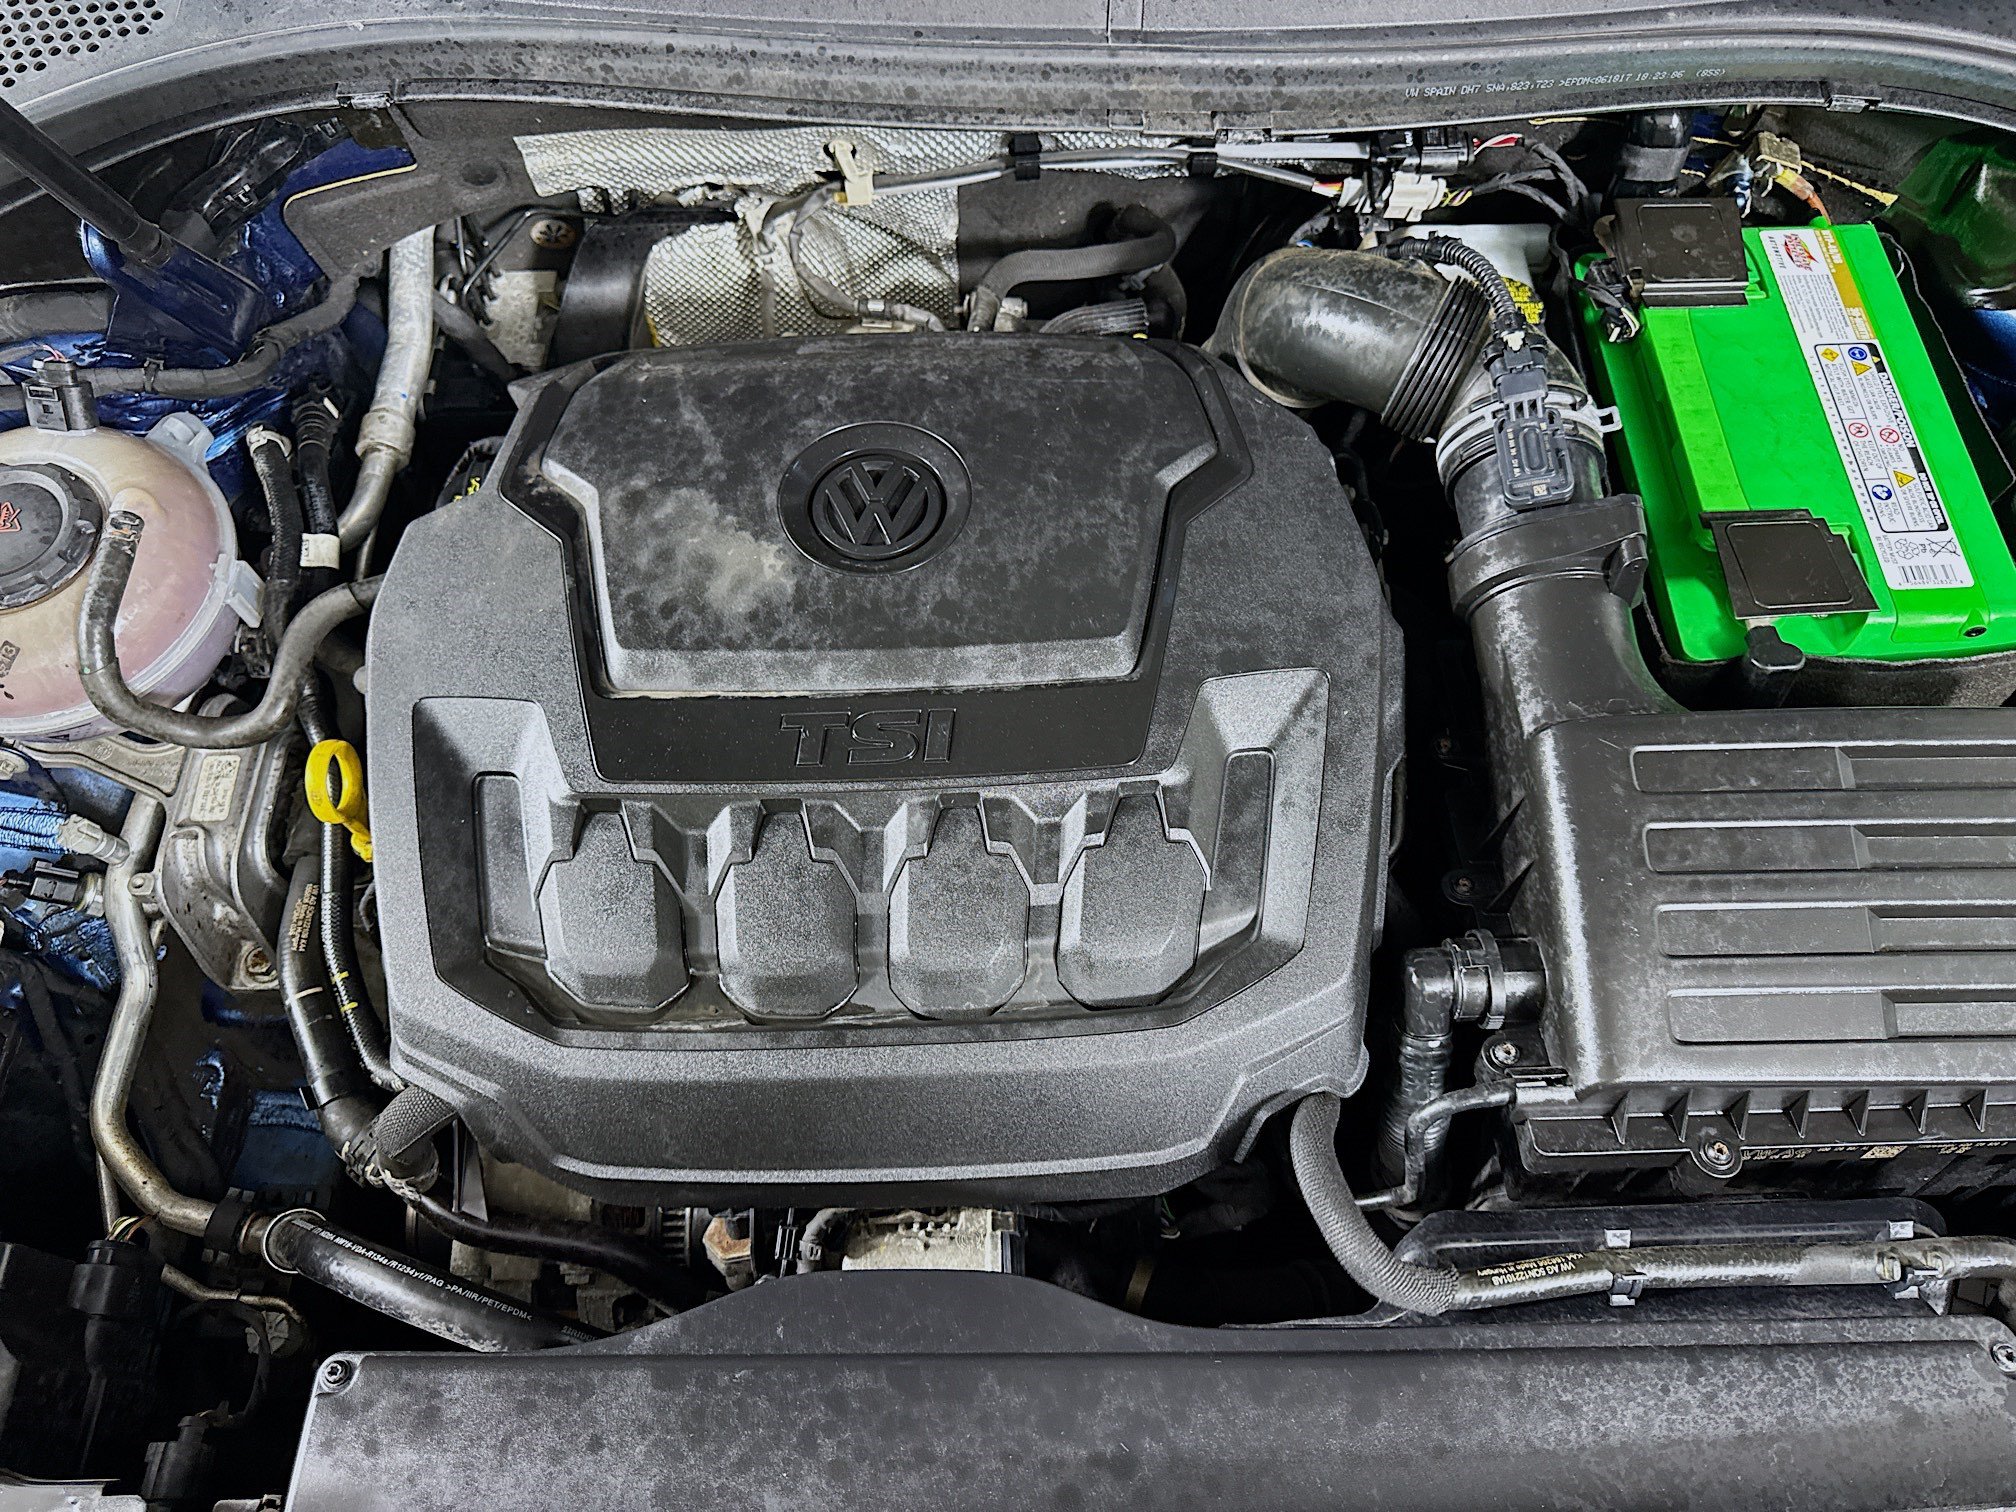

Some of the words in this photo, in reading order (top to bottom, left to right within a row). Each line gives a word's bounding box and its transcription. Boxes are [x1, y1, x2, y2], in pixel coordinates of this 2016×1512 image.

[1405, 88, 1419, 98] VW
[1424, 88, 1456, 96] SPAIN
[1461, 85, 1481, 95] DH7
[1768, 236, 1785, 269] AUTOMOTIVE
[1877, 372, 1917, 448] DANGER/POISON
[1911, 483, 1926, 504] SULFURIC
[1921, 506, 1931, 518] ACID
[1918, 543, 1928, 553] Pb
[780, 707, 956, 768] TSI
[1545, 1263, 1558, 1274] AG
[1560, 1260, 1575, 1271] VW
